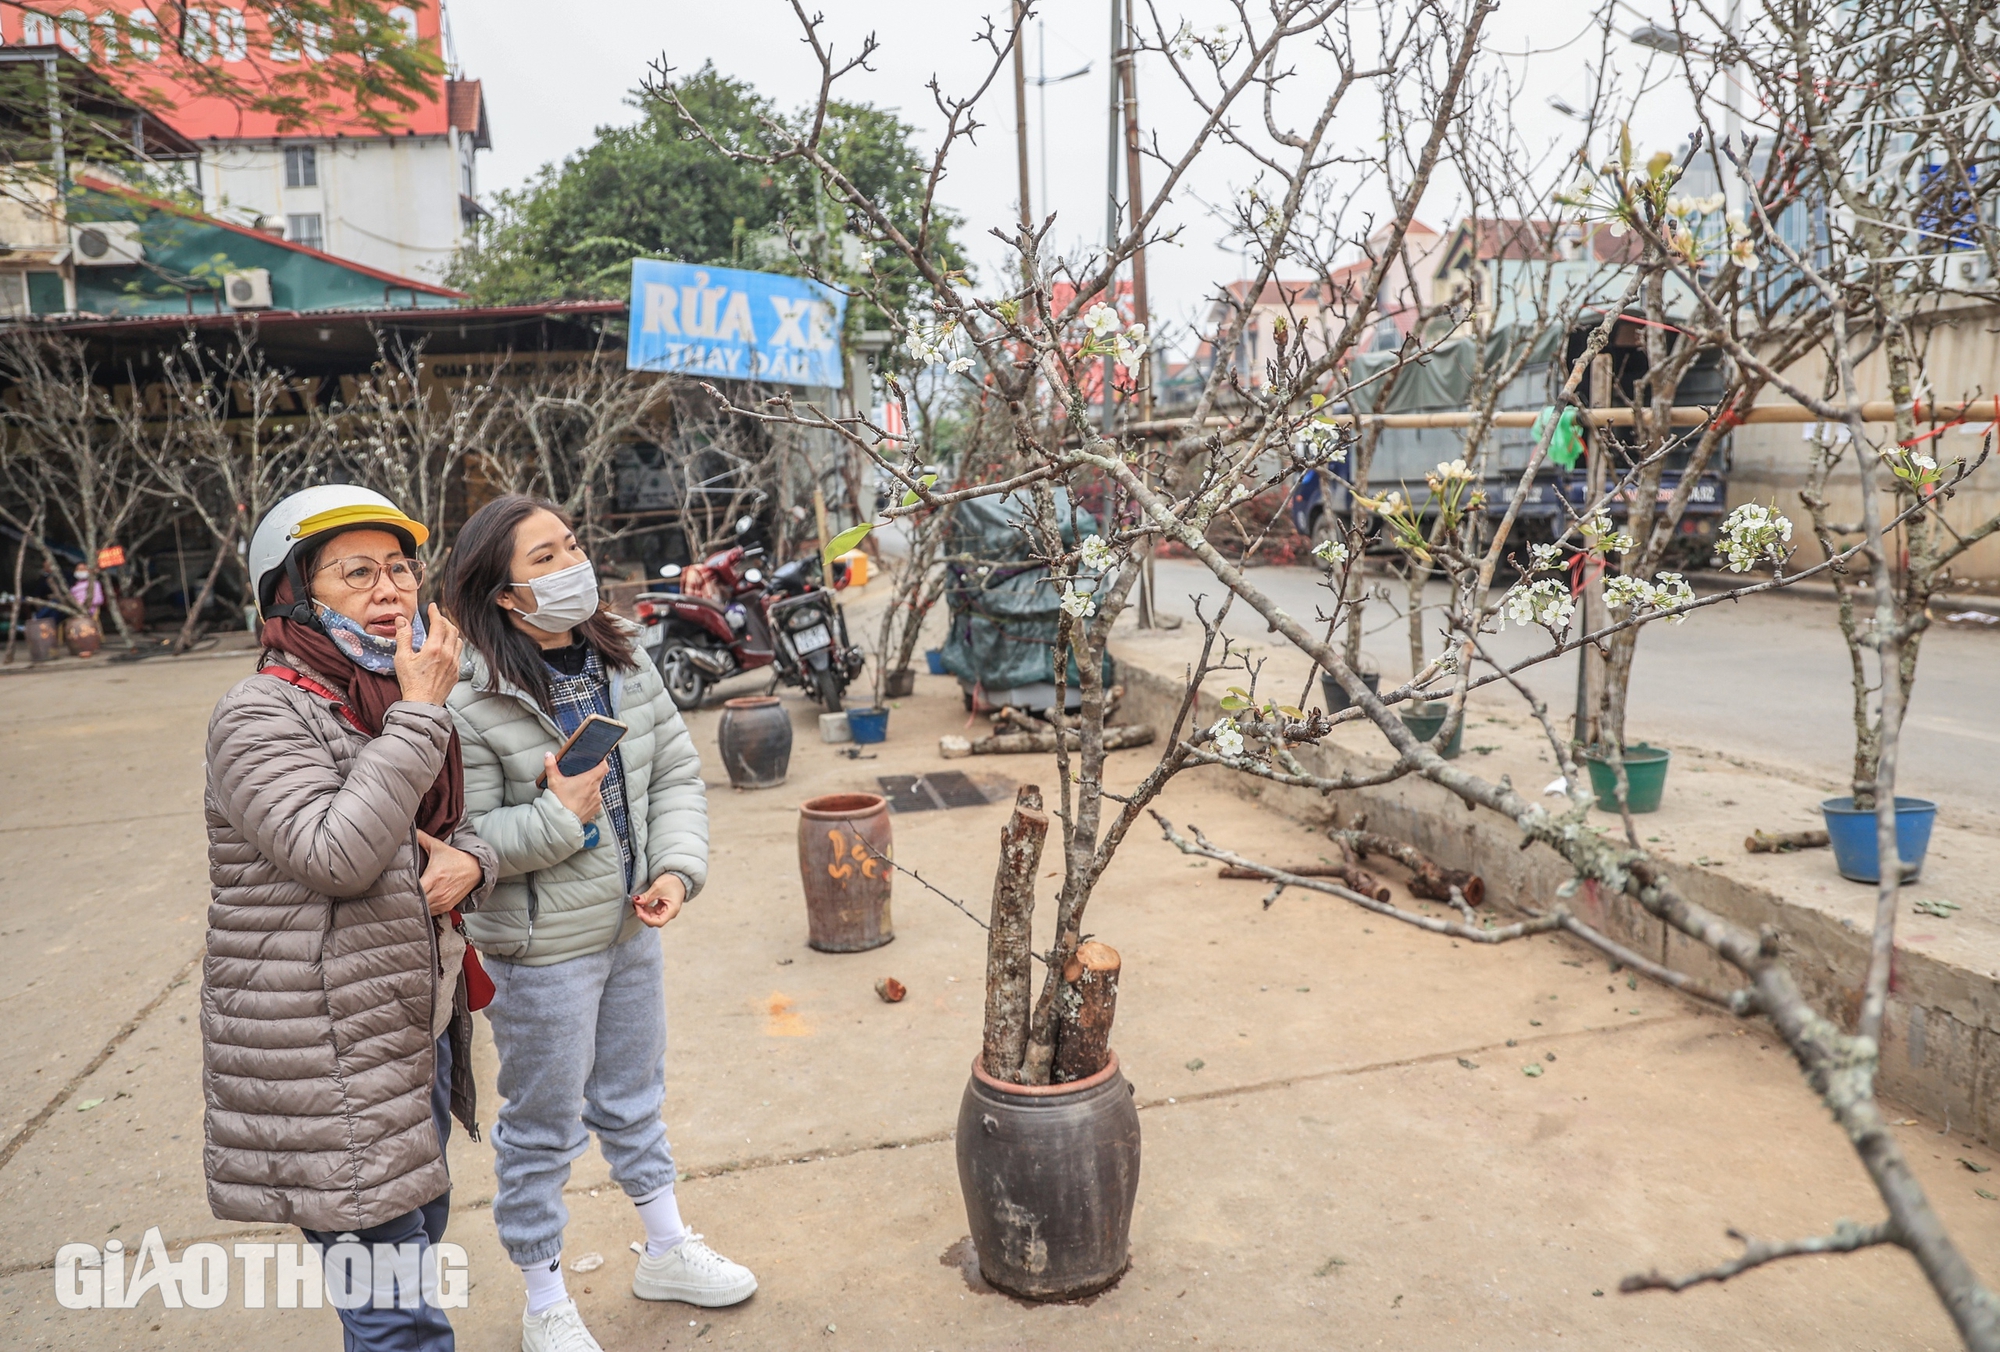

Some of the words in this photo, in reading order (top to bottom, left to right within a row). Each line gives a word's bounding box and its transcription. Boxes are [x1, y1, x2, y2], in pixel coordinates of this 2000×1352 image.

[642, 270, 757, 344] RỬA
[768, 295, 836, 352] XE
[665, 341, 743, 373] THAY
